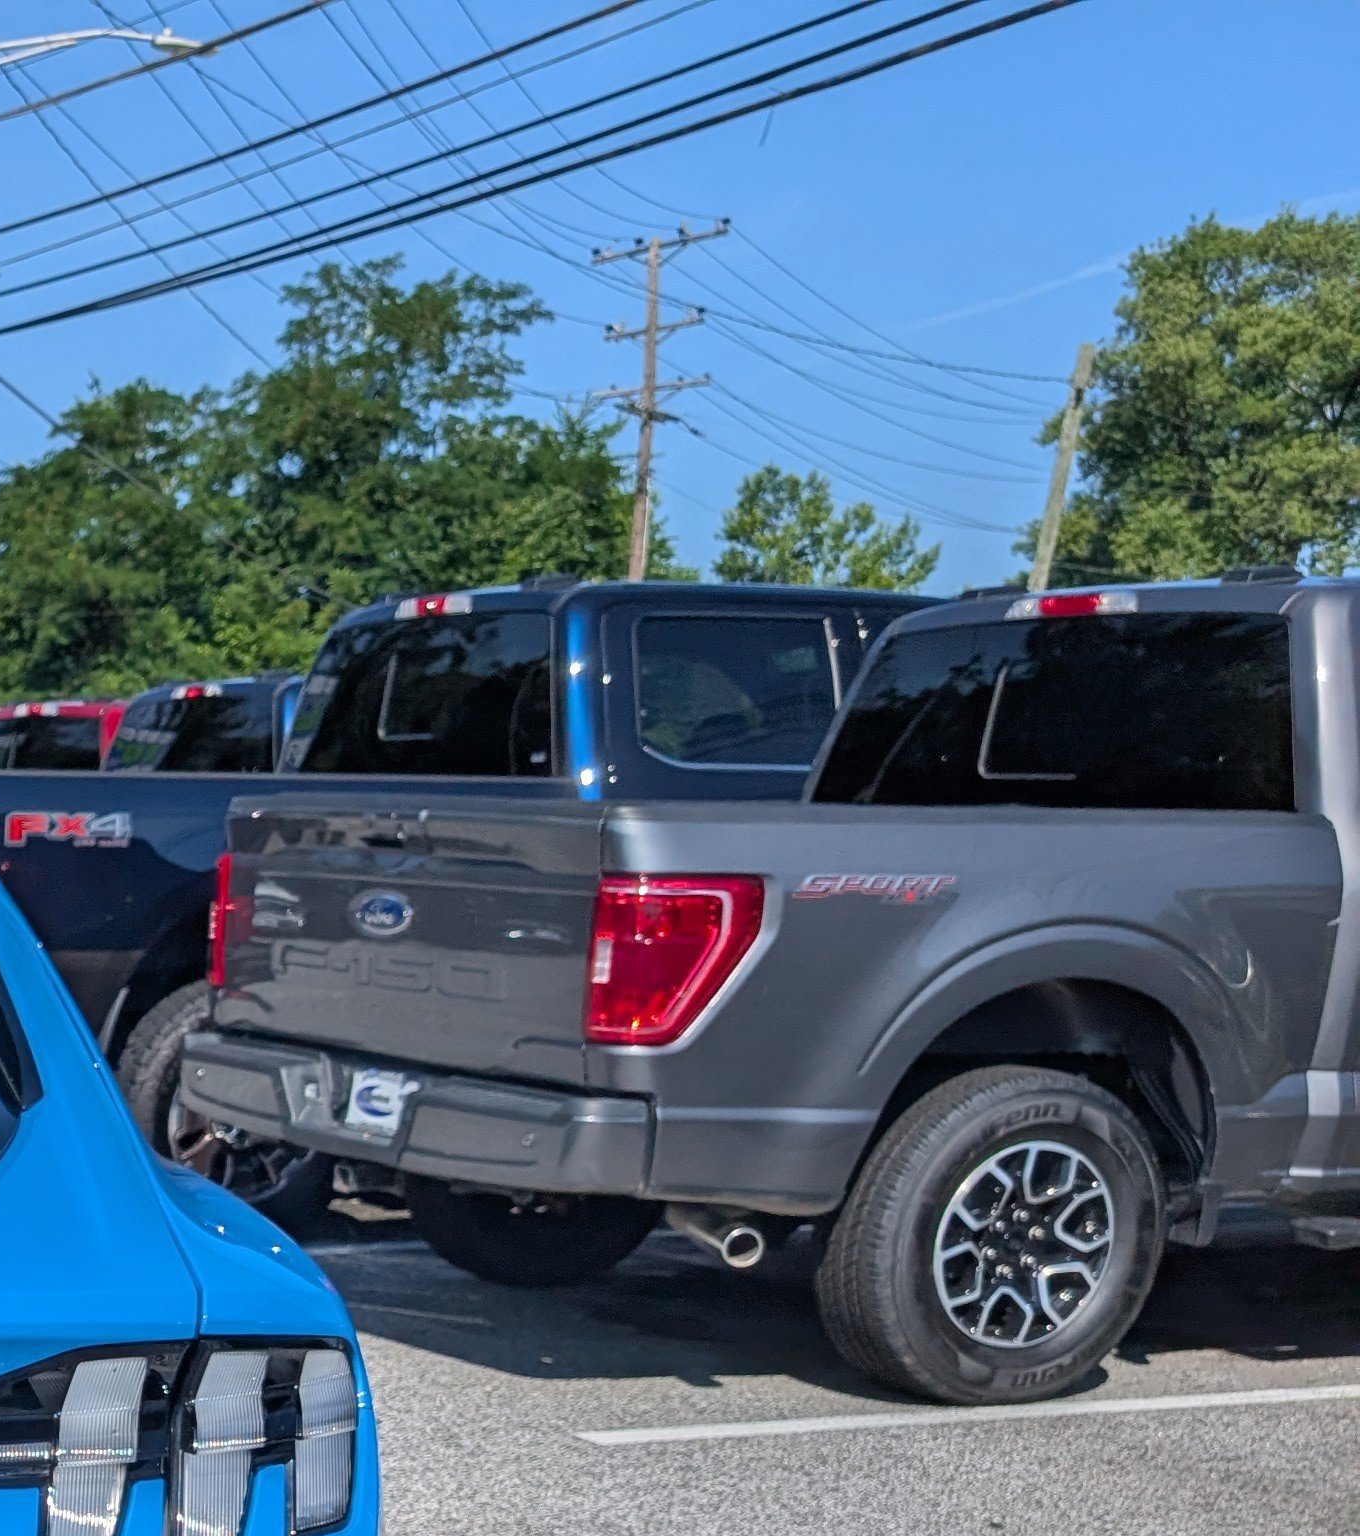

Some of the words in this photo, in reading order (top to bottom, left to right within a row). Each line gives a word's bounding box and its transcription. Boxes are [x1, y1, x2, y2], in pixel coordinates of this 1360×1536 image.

[4, 812, 131, 848] FX4
[792, 873, 957, 899] SPORT
[270, 940, 506, 1003] F-150
